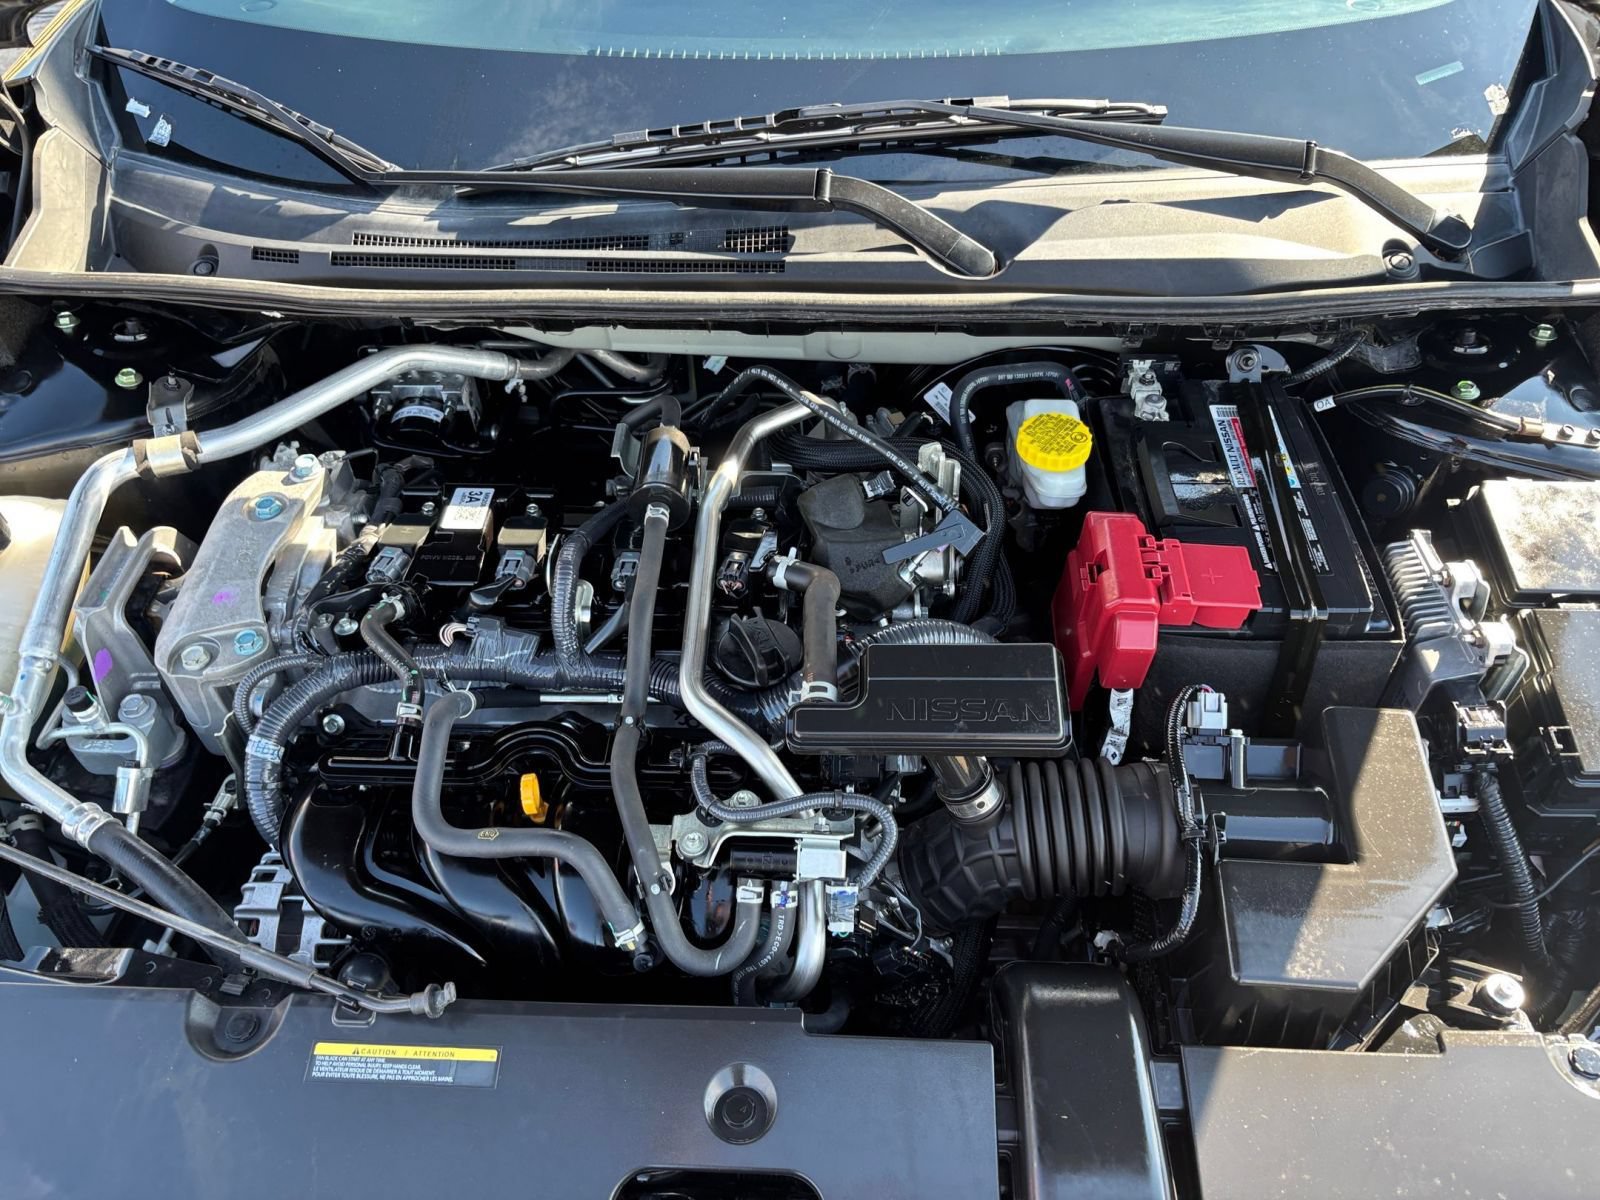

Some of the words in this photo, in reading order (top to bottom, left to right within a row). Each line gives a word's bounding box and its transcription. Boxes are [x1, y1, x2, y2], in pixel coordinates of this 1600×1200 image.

[858, 434, 872, 446] KINK
[1217, 419, 1235, 453] NISSAN
[1229, 454, 1247, 486] RENAULT
[466, 491, 483, 504] 3A
[886, 698, 1051, 722] NISSAN
